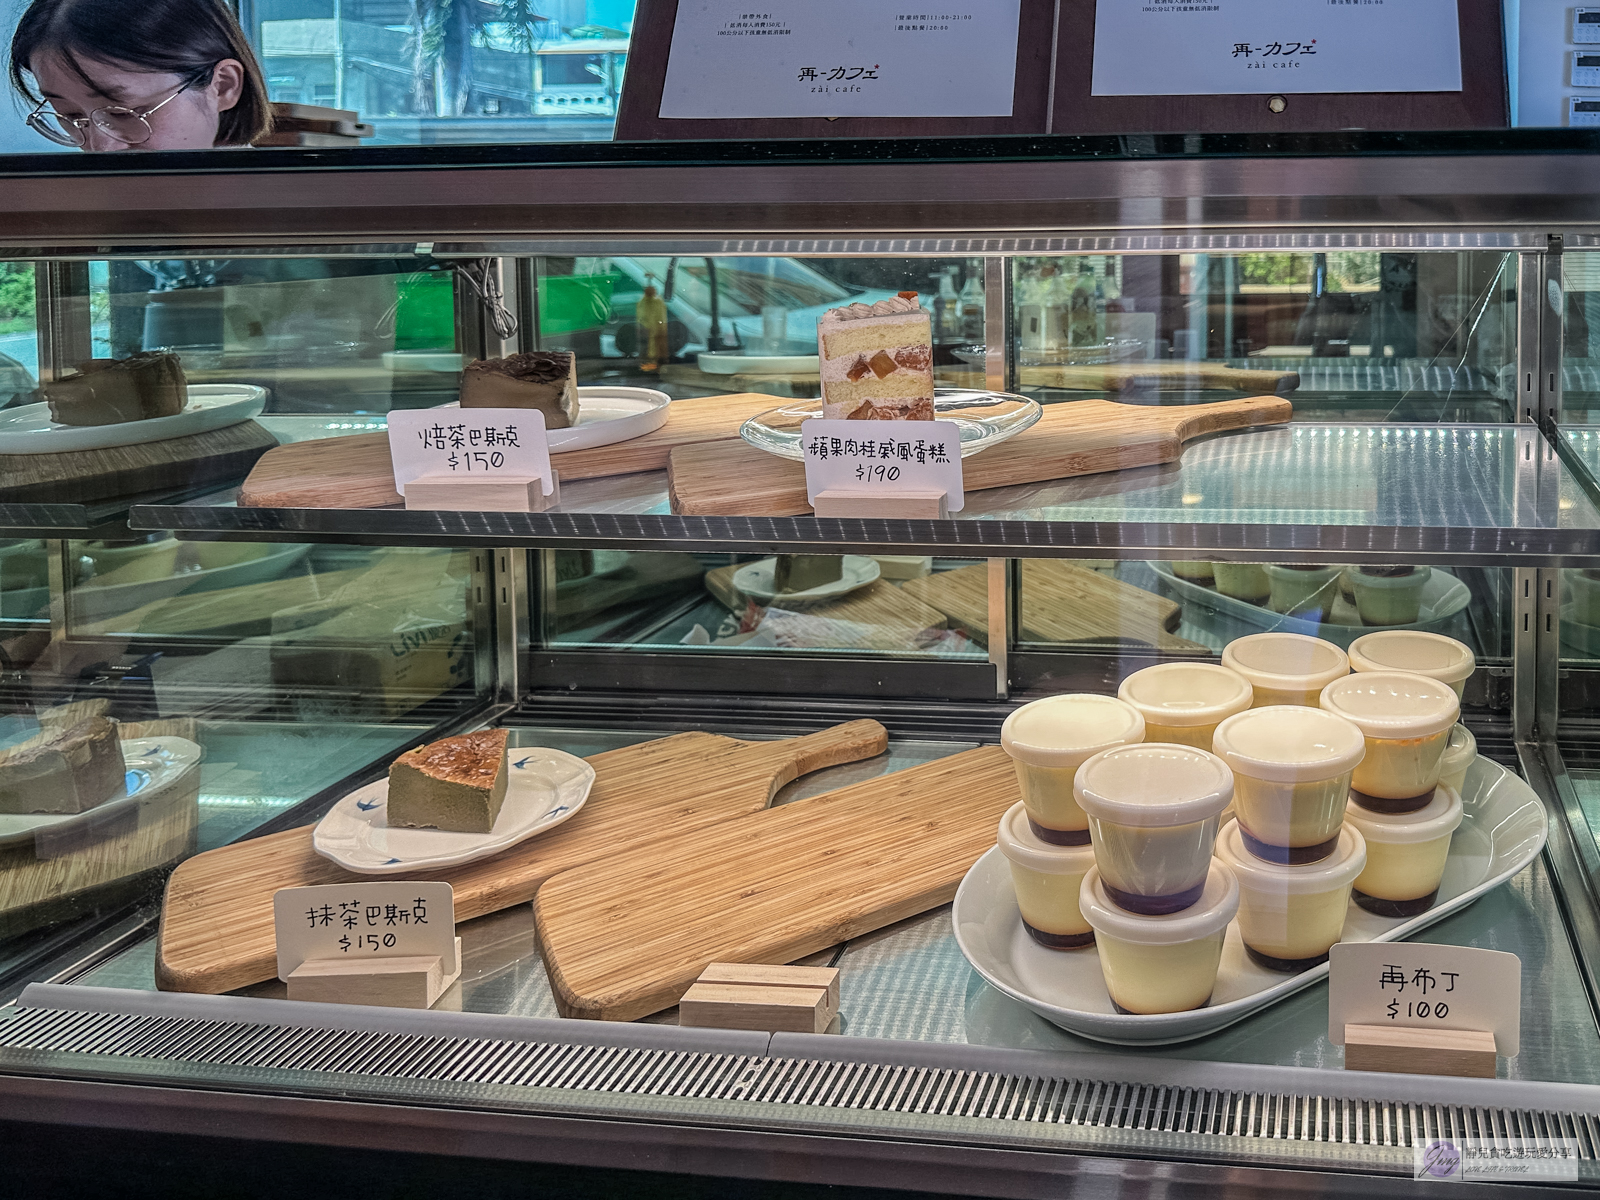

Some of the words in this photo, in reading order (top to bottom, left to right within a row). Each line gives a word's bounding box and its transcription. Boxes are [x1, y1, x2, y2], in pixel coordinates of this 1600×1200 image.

[1272, 59, 1301, 69] cafe
[835, 84, 862, 93] cafe
[418, 423, 521, 450] 焙茶巴斯克
[447, 451, 505, 471] $150
[855, 464, 901, 482] $190
[305, 897, 429, 930] 抹茶巴斯克
[338, 933, 397, 952] $150
[1379, 964, 1460, 995] 再布丁
[1386, 998, 1449, 1019] $100
